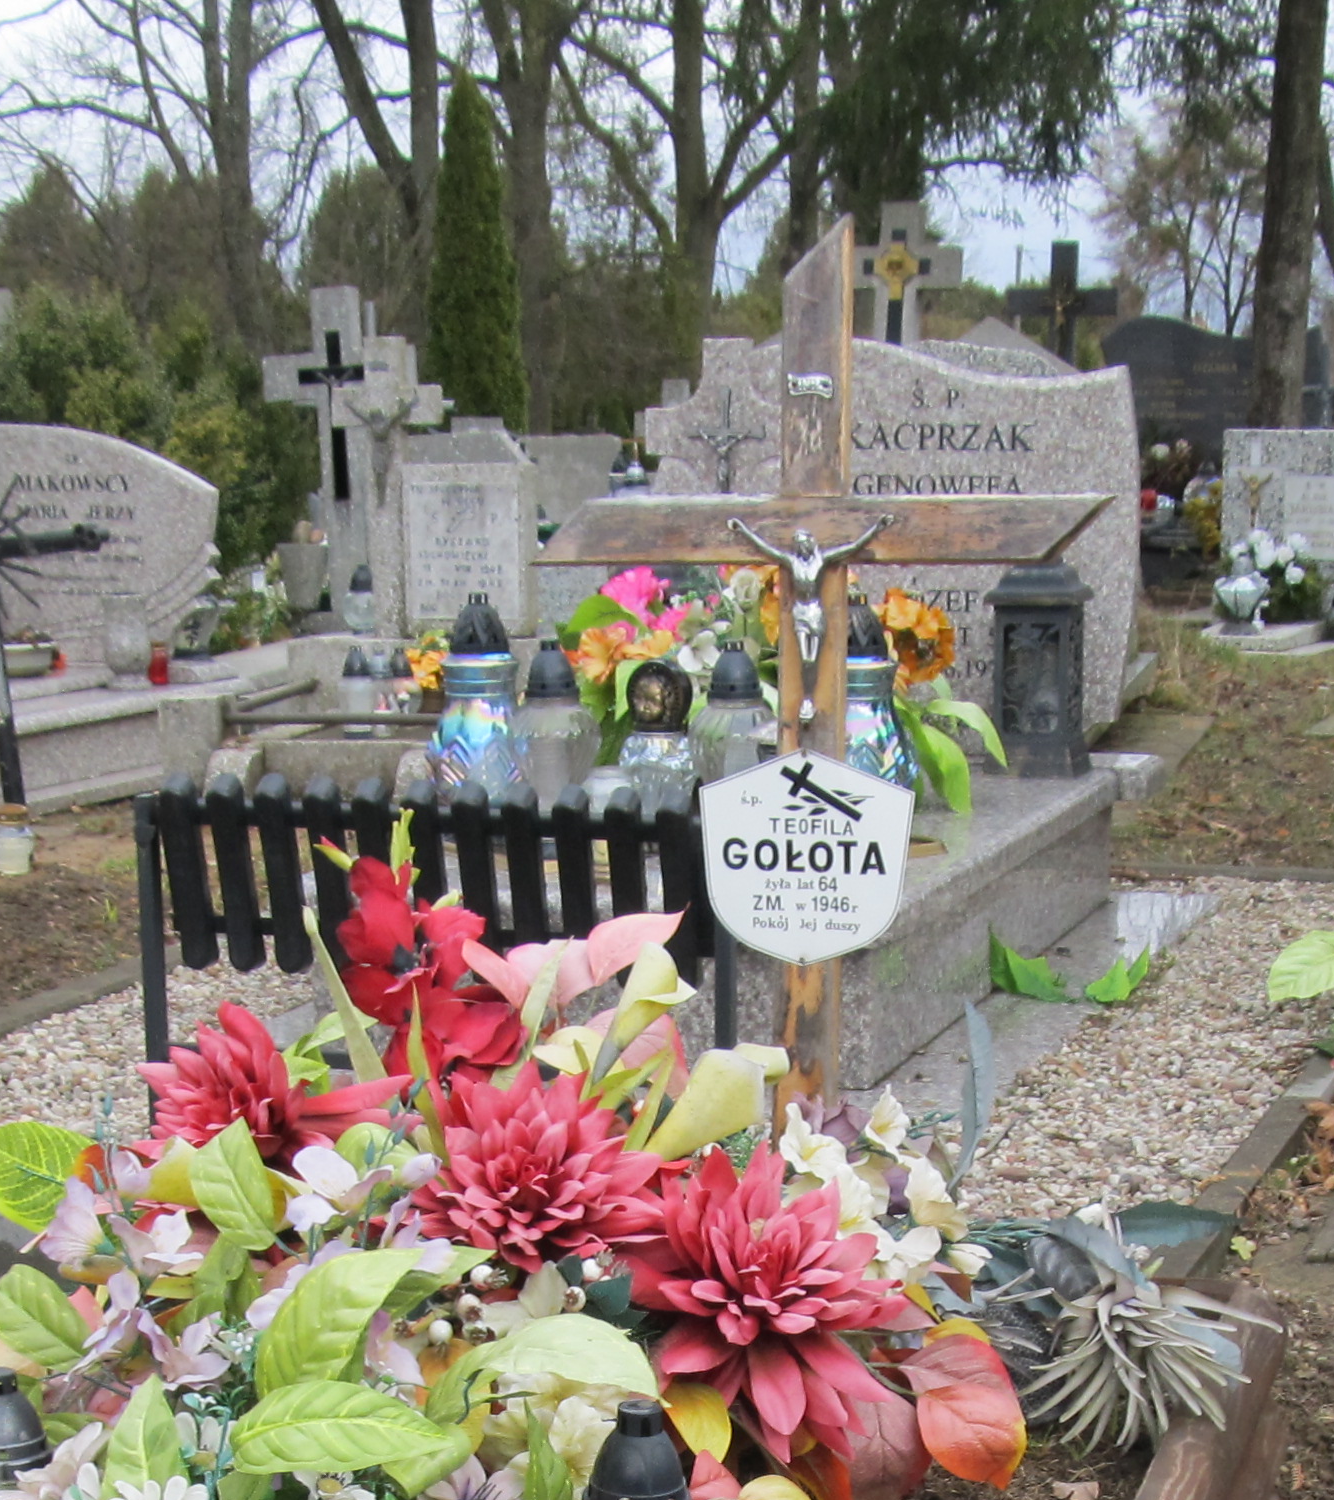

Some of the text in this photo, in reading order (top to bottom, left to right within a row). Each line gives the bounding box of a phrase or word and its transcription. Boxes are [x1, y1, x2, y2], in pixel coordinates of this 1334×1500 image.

[947, 389, 965, 409] P.
[16, 473, 130, 494] MAKOWSCY
[853, 473, 1024, 495] GENOWEFA
[18, 503, 136, 521] MARIA JERZY
[740, 791, 763, 807] ś.p.
[769, 818, 854, 836] TEOFILA
[722, 837, 887, 875] GOŁOTA
[764, 876, 838, 892] żyła lat 64
[752, 895, 785, 911] ZM.
[795, 902, 806, 911] w
[752, 915, 861, 935] Pokój Jej duszy
